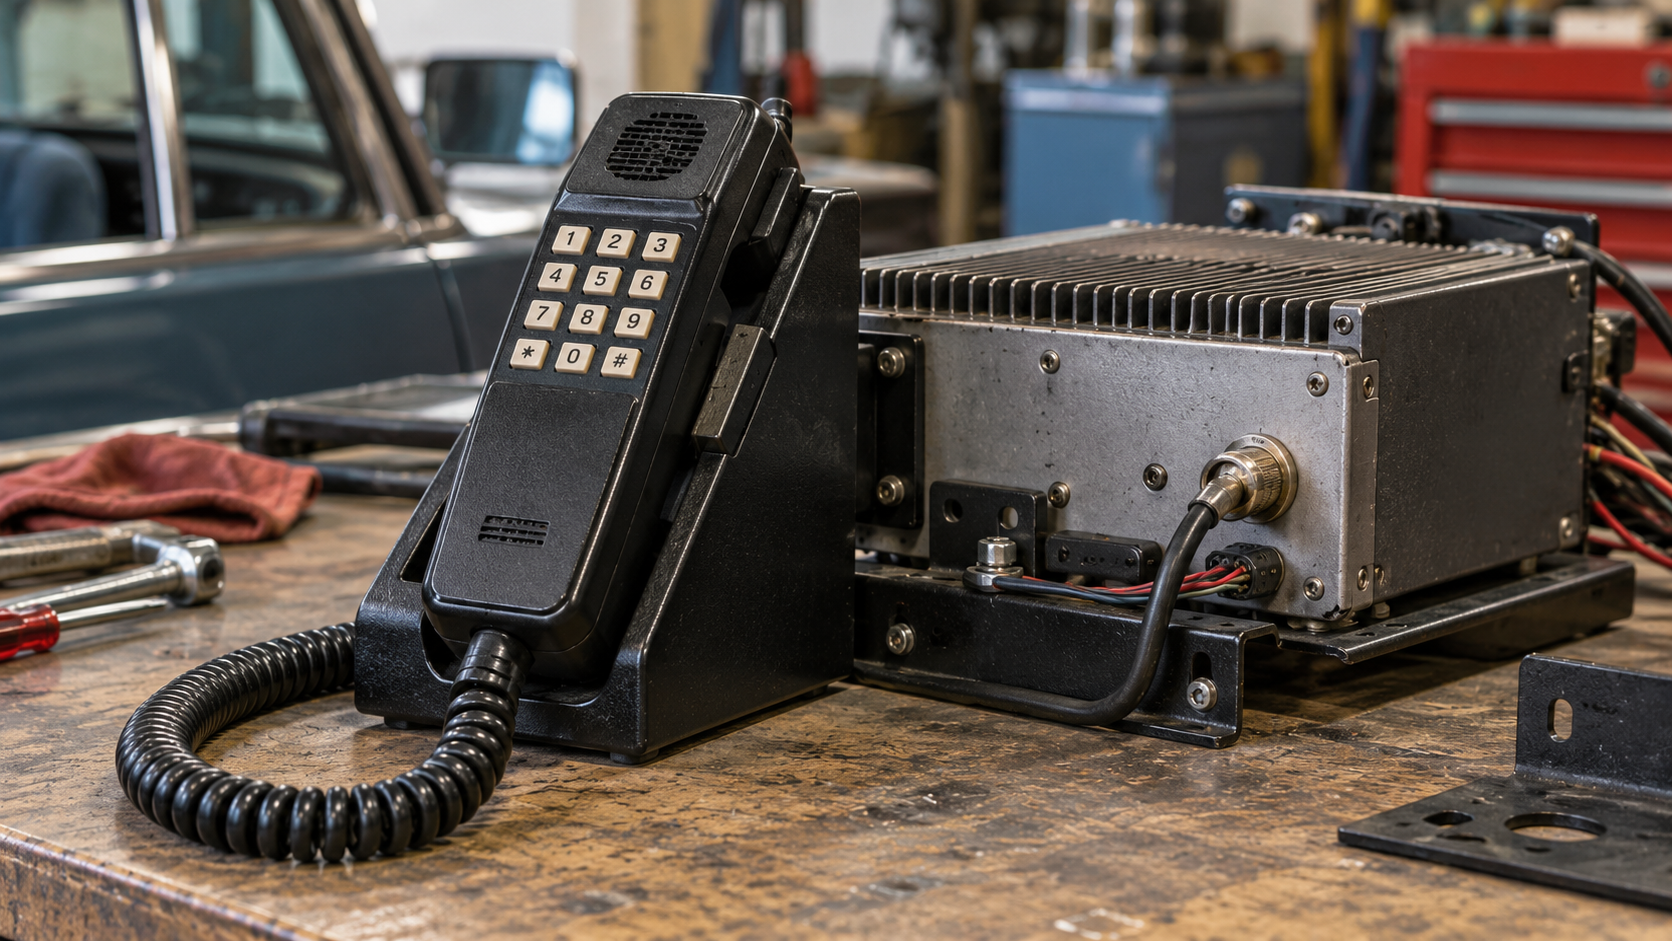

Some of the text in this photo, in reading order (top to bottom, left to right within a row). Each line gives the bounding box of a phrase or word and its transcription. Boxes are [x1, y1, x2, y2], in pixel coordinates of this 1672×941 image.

[567, 231, 667, 252] 1 2 3
[549, 268, 653, 290] 4 5 6
[536, 306, 640, 328] 7 8 9
[566, 349, 580, 363] 0
[613, 353, 627, 367] #
